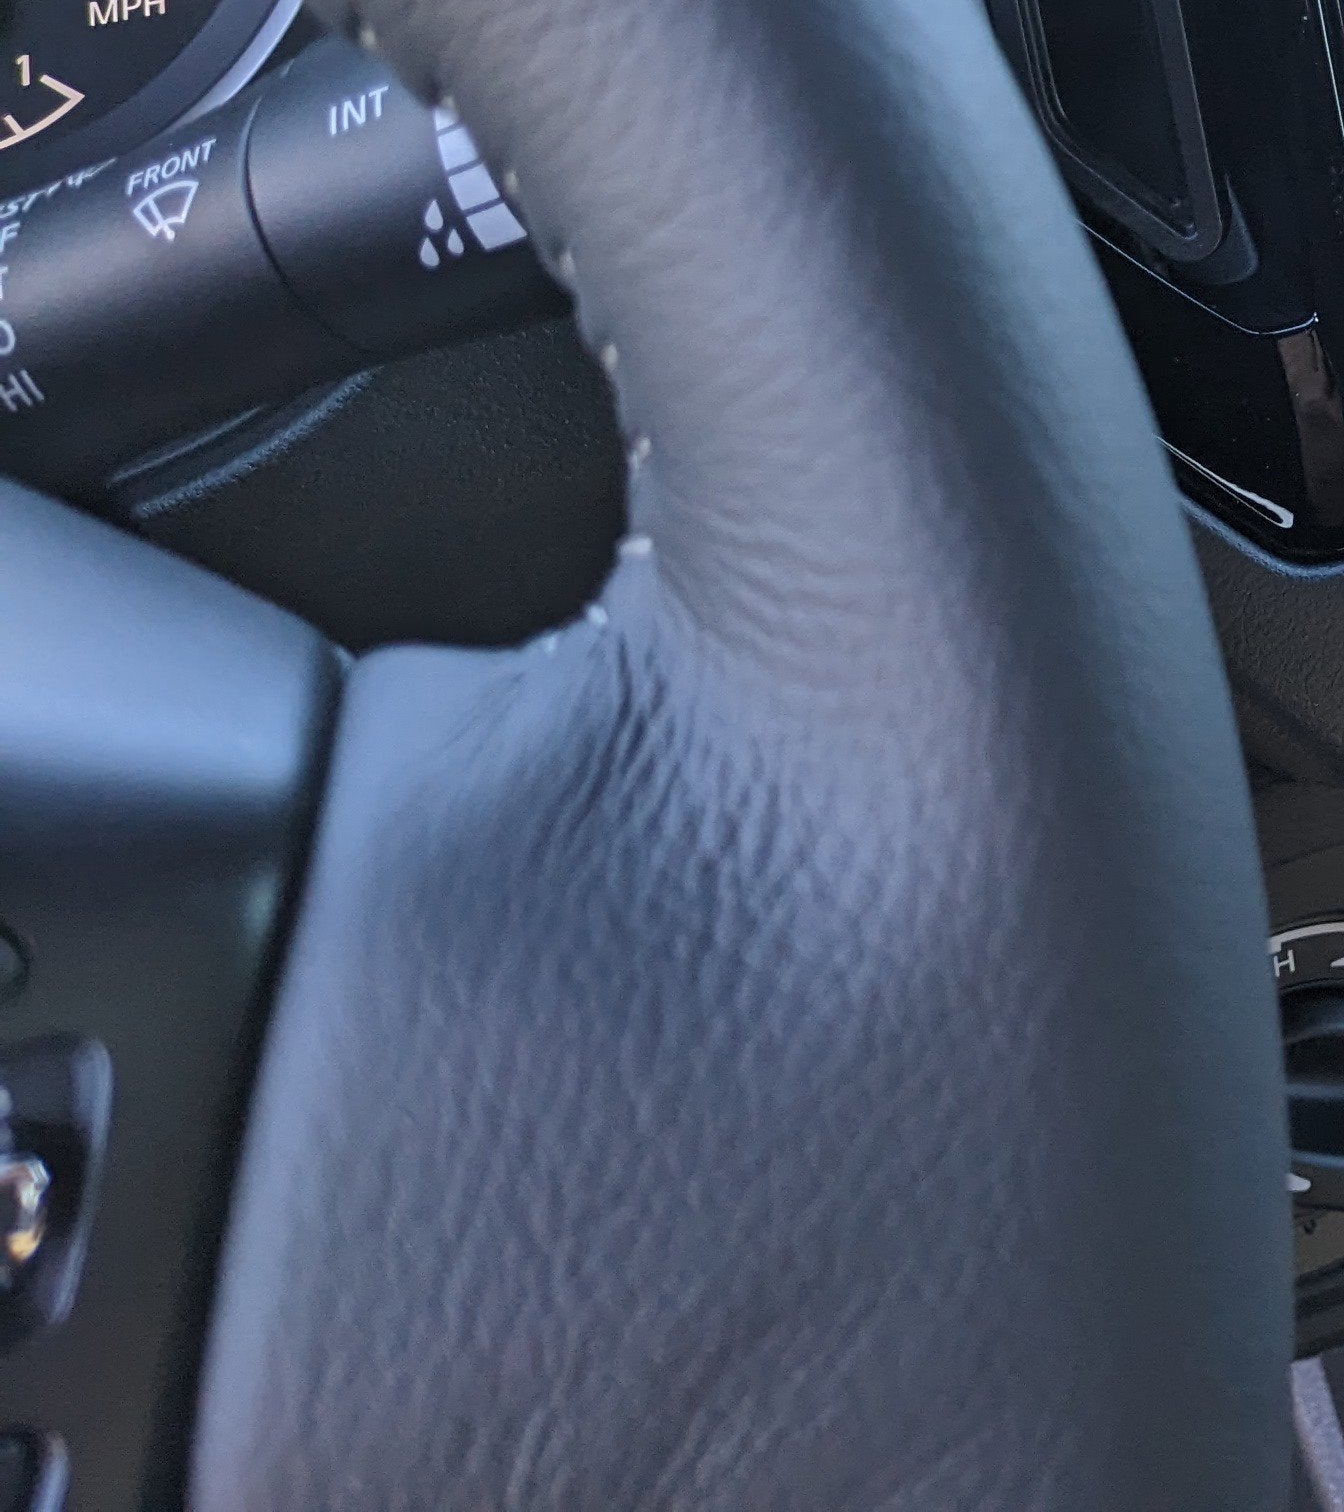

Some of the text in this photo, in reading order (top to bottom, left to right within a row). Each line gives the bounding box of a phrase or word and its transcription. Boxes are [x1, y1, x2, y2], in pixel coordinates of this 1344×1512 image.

[14, 53, 32, 87] 1
[328, 85, 390, 136] INT
[125, 137, 217, 197] FRONT
